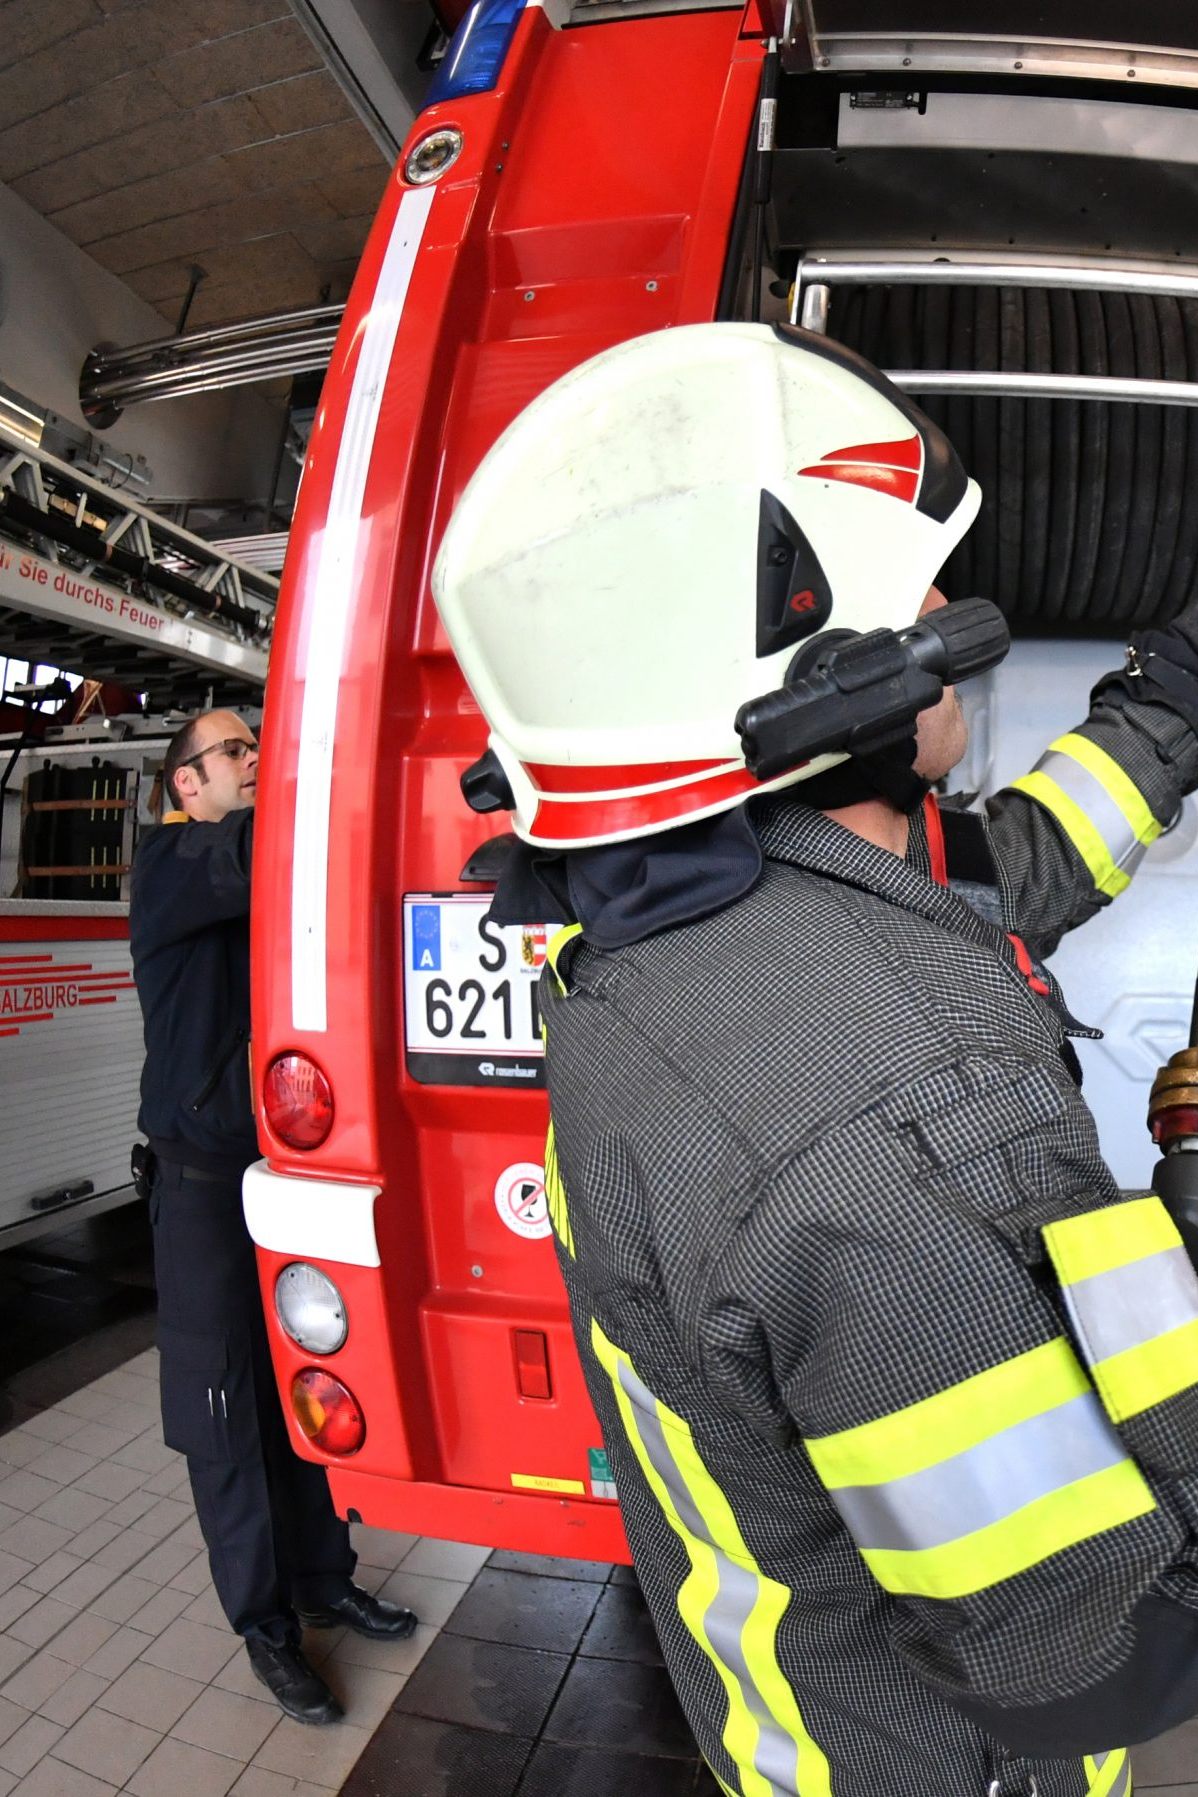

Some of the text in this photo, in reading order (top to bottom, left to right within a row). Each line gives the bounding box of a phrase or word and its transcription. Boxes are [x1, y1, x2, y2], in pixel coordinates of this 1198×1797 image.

[19, 555, 48, 585] Sie
[54, 573, 114, 613] durchs
[119, 598, 165, 631] Feuer
[420, 949, 434, 967] A
[479, 913, 507, 972] S
[0, 983, 78, 1013] ALZBURG
